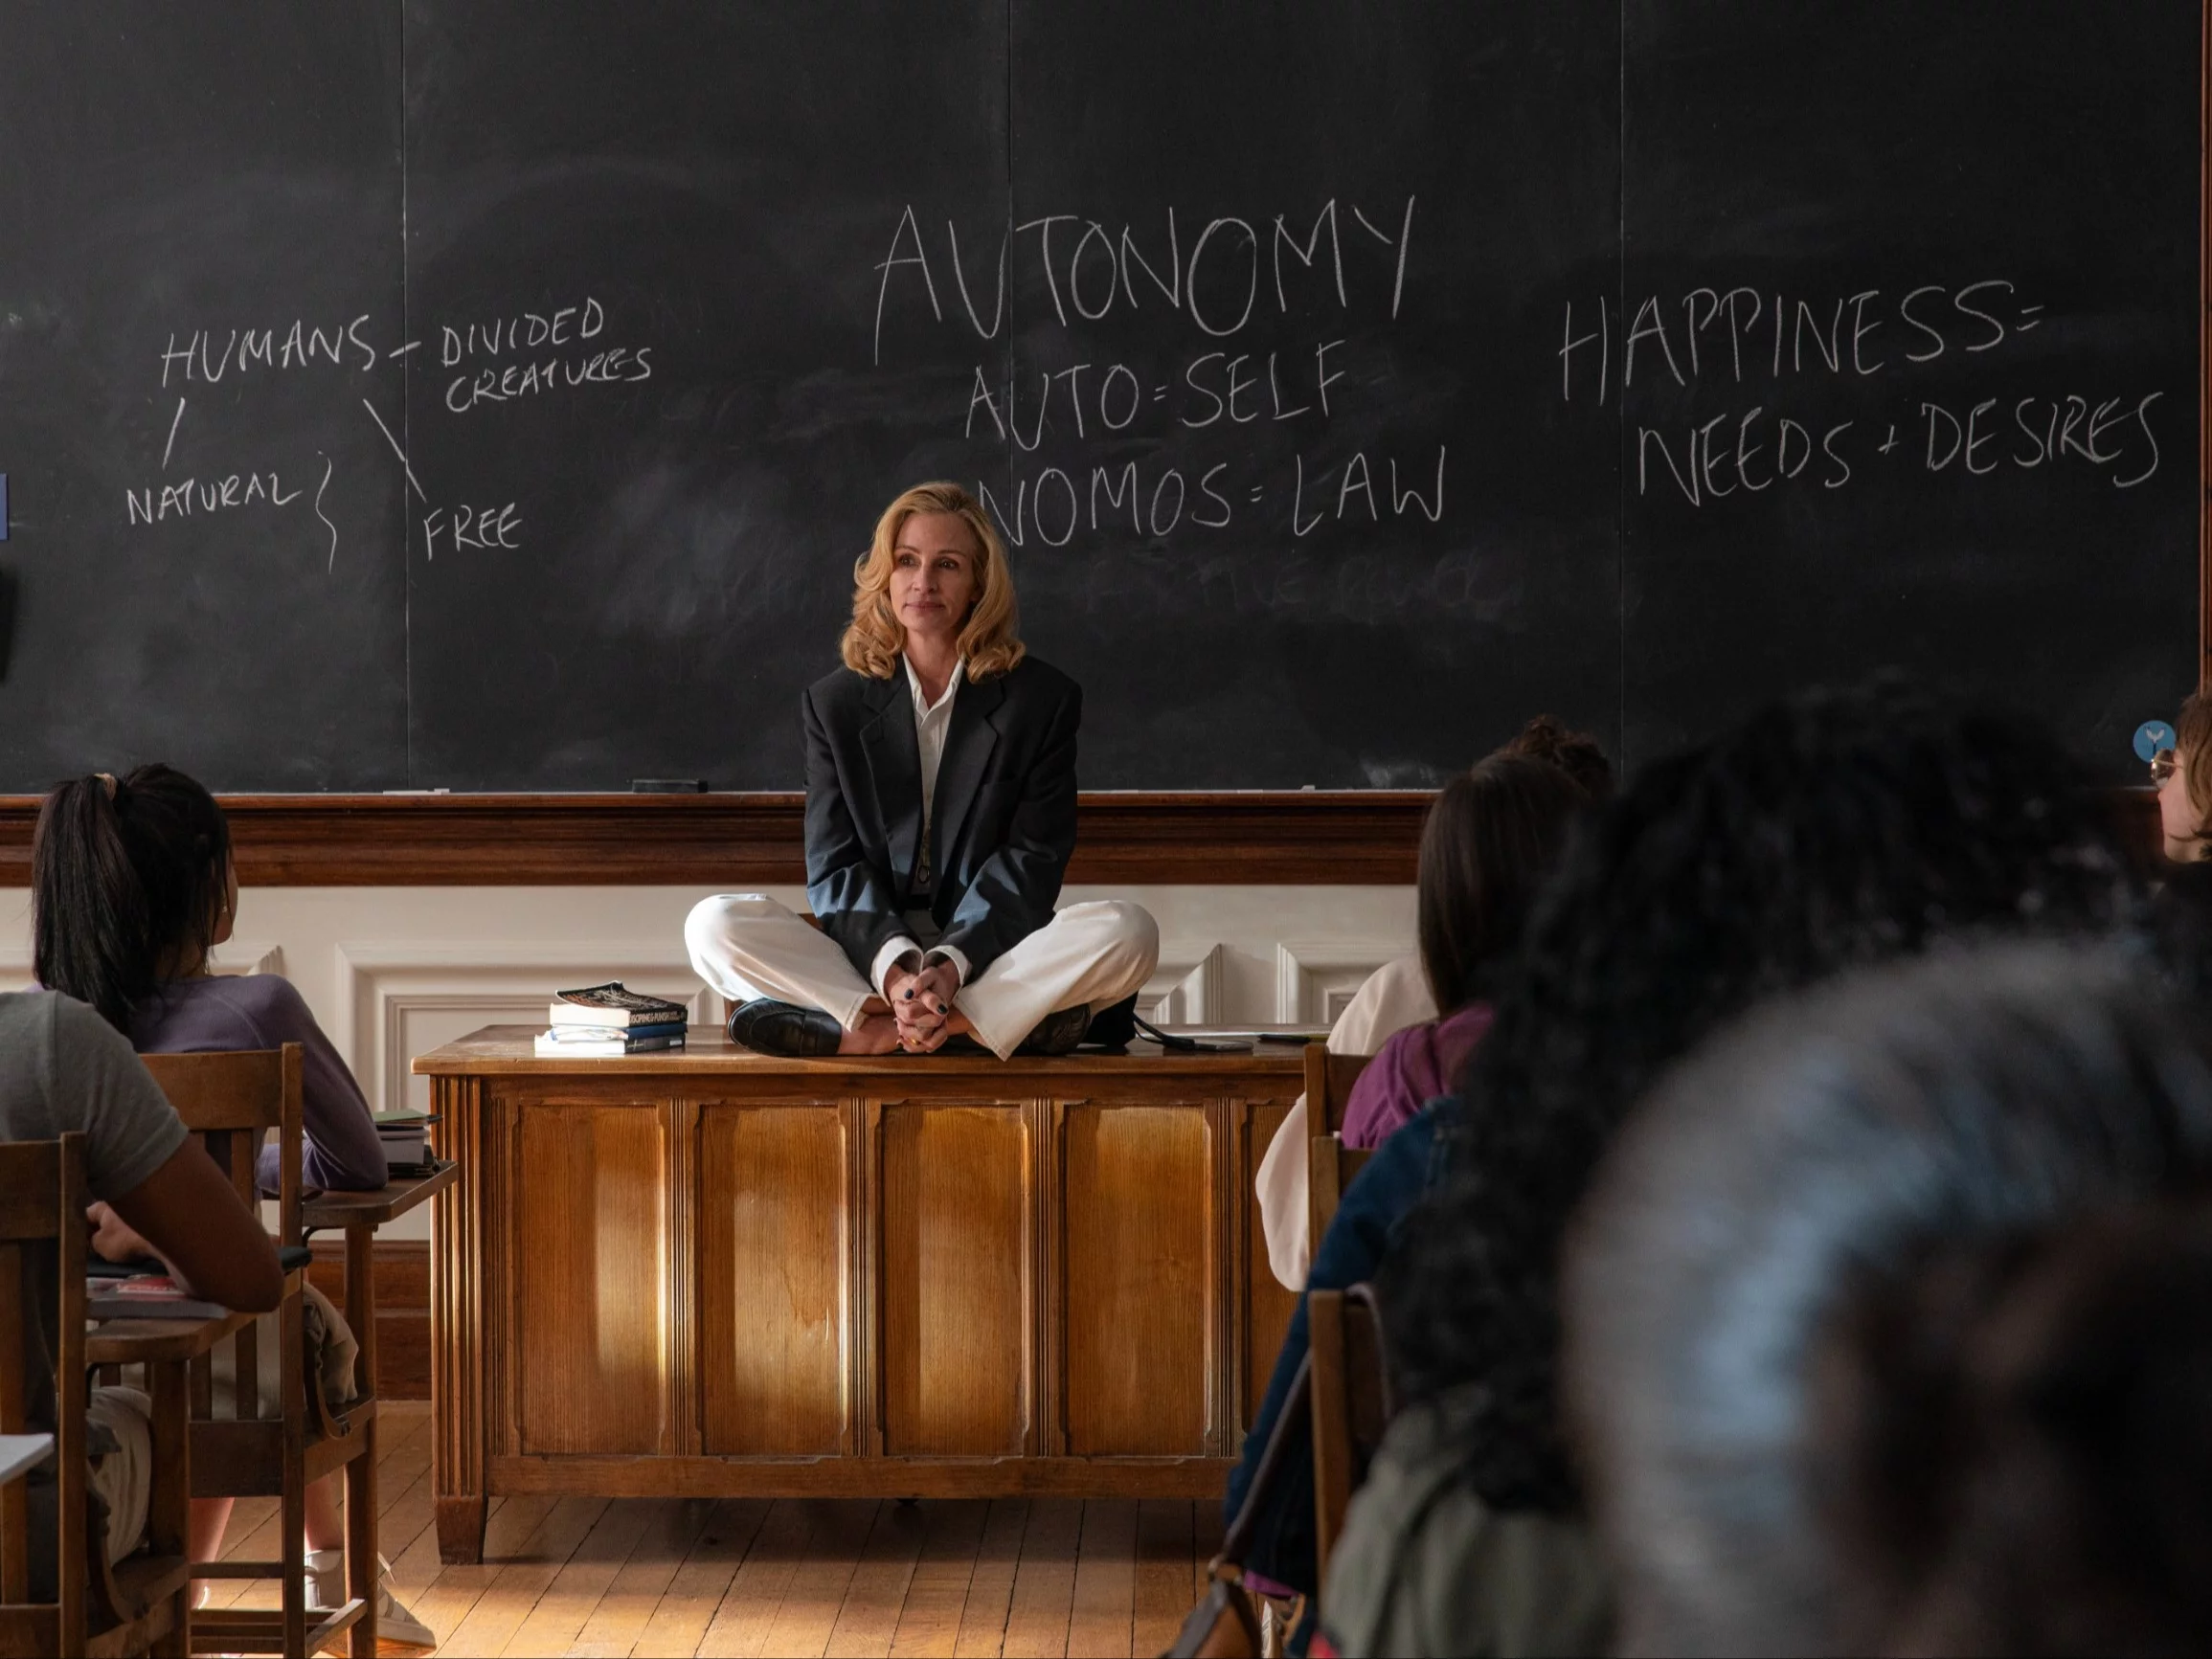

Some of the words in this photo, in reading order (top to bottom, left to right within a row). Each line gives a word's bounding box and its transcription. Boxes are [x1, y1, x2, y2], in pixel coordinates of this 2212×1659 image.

[874, 194, 1414, 366] AUTONOMY
[161, 314, 375, 388] HUMANS
[441, 297, 605, 369] DIVIDED
[445, 347, 652, 413] CREATURES
[1639, 407, 1854, 506] NEEDS
[1921, 392, 2164, 487] DESIRES
[126, 473, 302, 525] NATURAL
[423, 503, 522, 561] FREE
